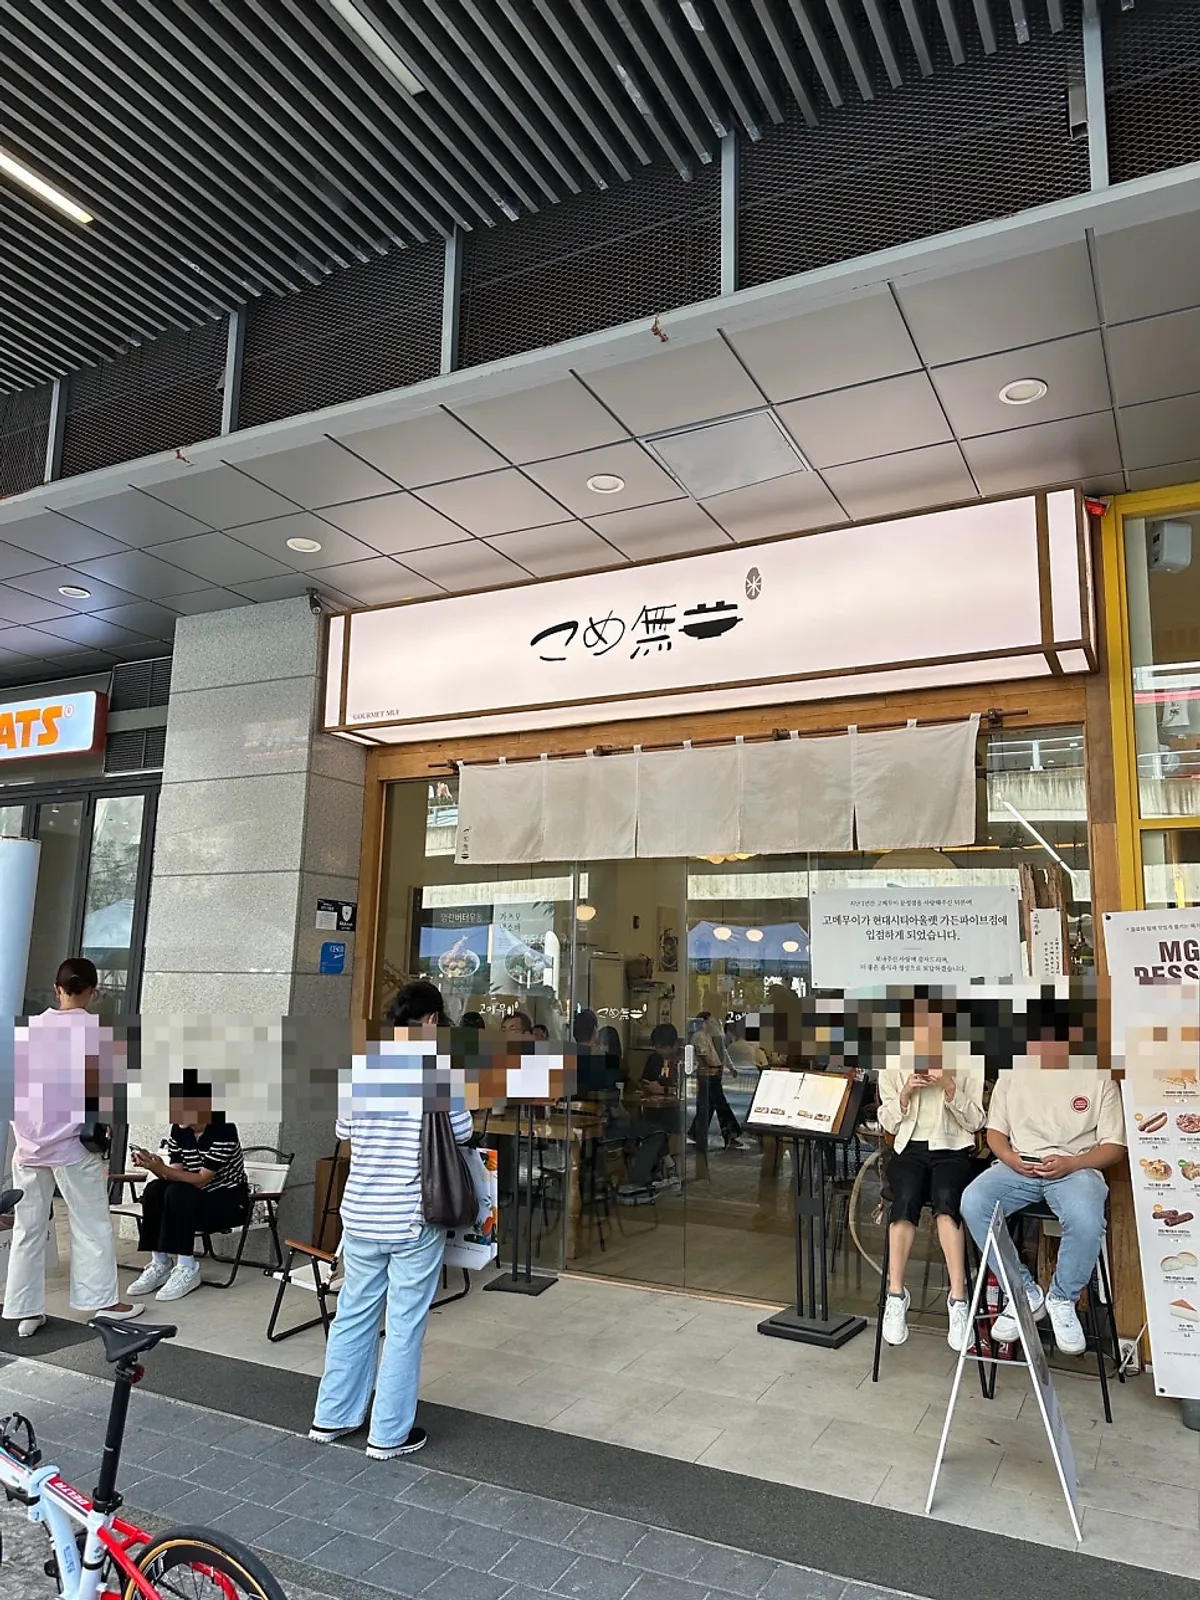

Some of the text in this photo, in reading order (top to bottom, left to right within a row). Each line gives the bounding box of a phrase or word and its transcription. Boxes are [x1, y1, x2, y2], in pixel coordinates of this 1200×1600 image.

[822, 914, 1008, 926] 고메무이가 현대시티아울렛 가든파이브점에
[865, 929, 961, 941] 입점하게 되었습니다.
